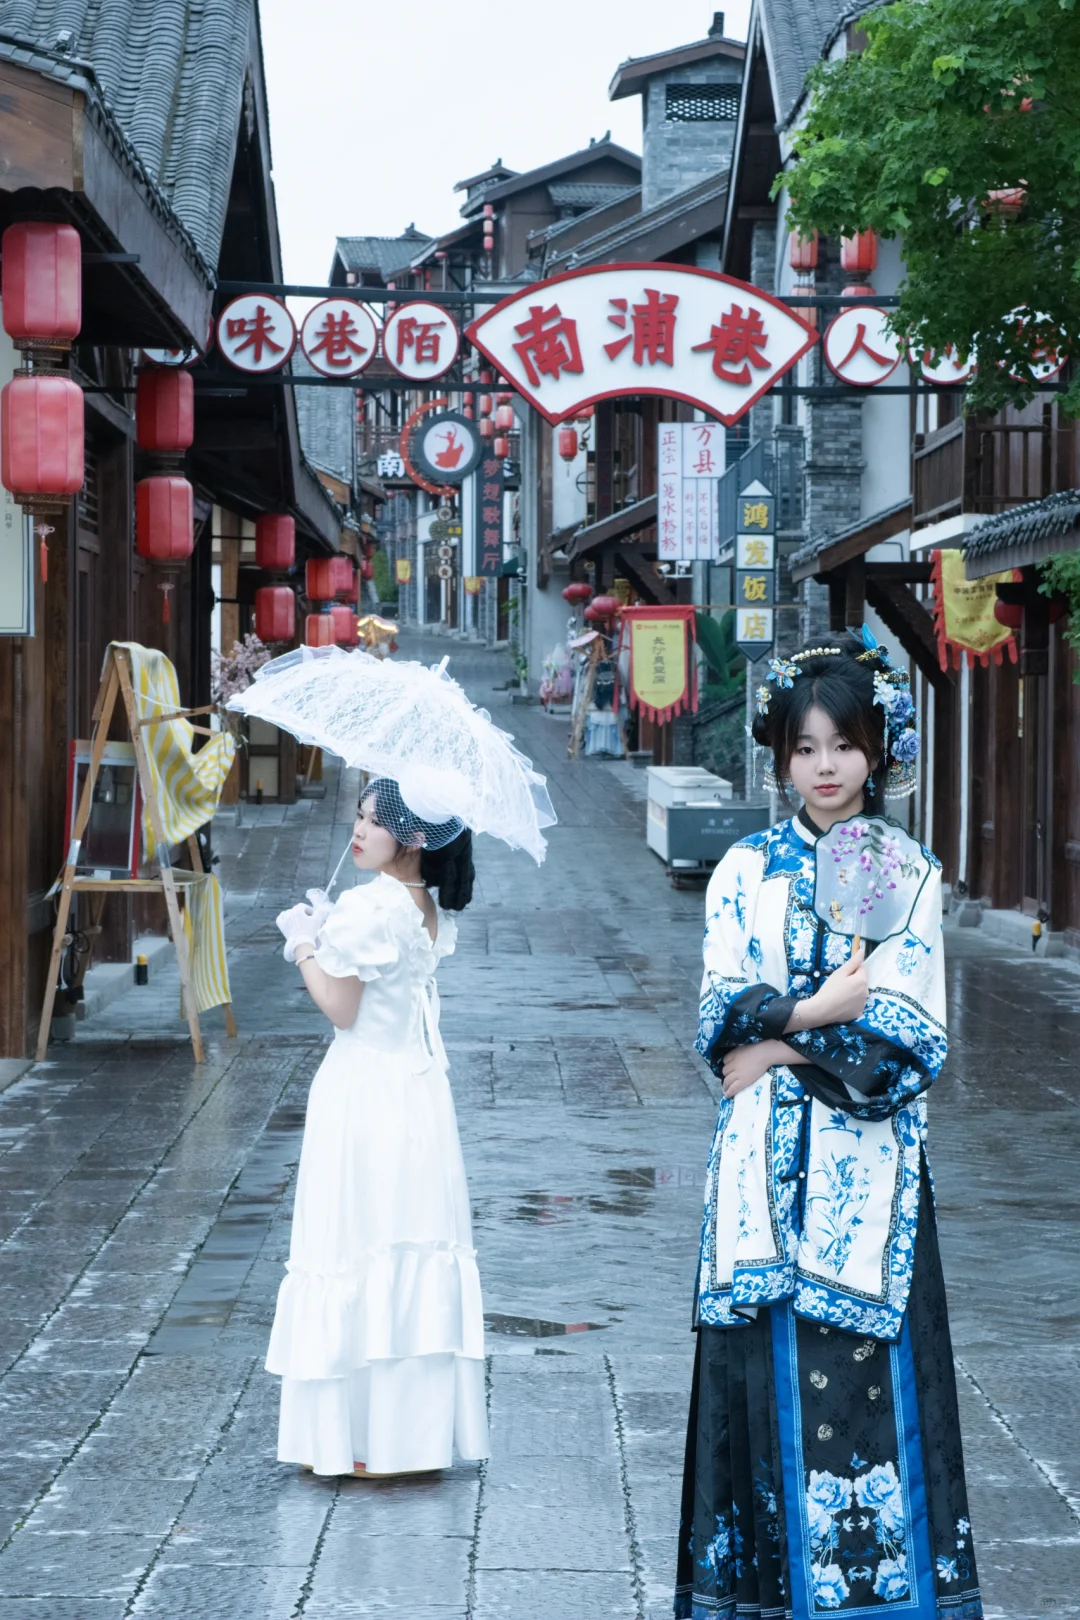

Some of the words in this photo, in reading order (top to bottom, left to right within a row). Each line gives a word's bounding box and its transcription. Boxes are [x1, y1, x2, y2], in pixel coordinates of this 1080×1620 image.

[226, 304, 447, 366] 味巷陌
[512, 288, 772, 387] 南浦巷
[377, 449, 405, 478] 南
[692, 424, 716, 474] 万县
[743, 502, 769, 639] 鸿发饭店
